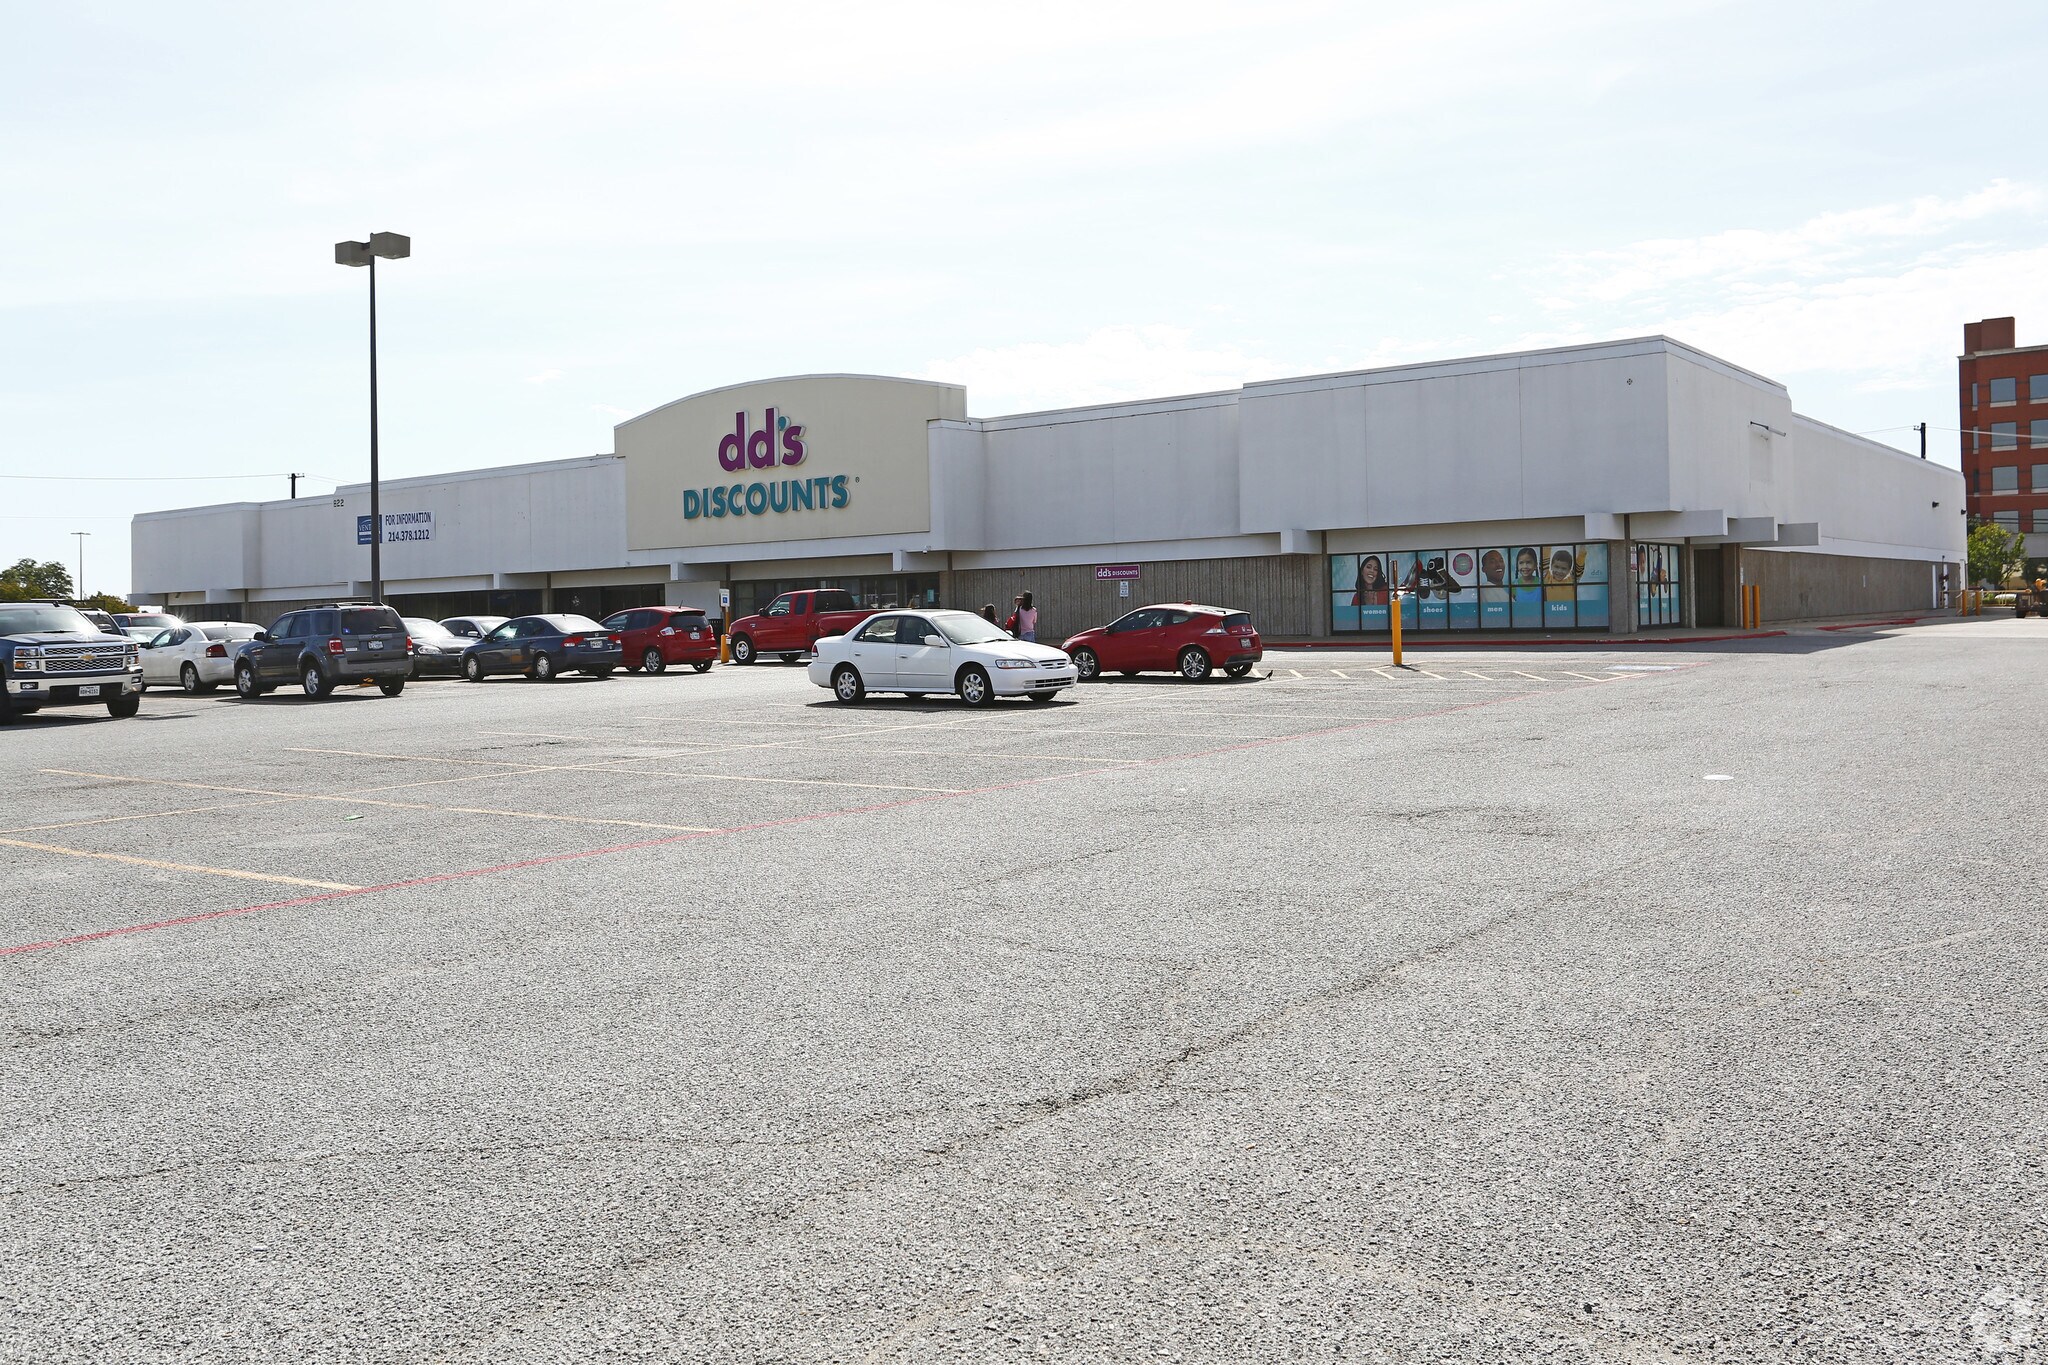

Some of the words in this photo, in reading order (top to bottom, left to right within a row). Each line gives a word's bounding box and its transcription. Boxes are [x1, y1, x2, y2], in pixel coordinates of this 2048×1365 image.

[718, 407, 807, 473] dd's
[683, 474, 851, 520] DISCOUNTS
[385, 514, 396, 526] FOR
[396, 511, 432, 525] INFORMATION
[388, 529, 430, 542] 214.378.1212
[1097, 568, 1112, 577] dd's
